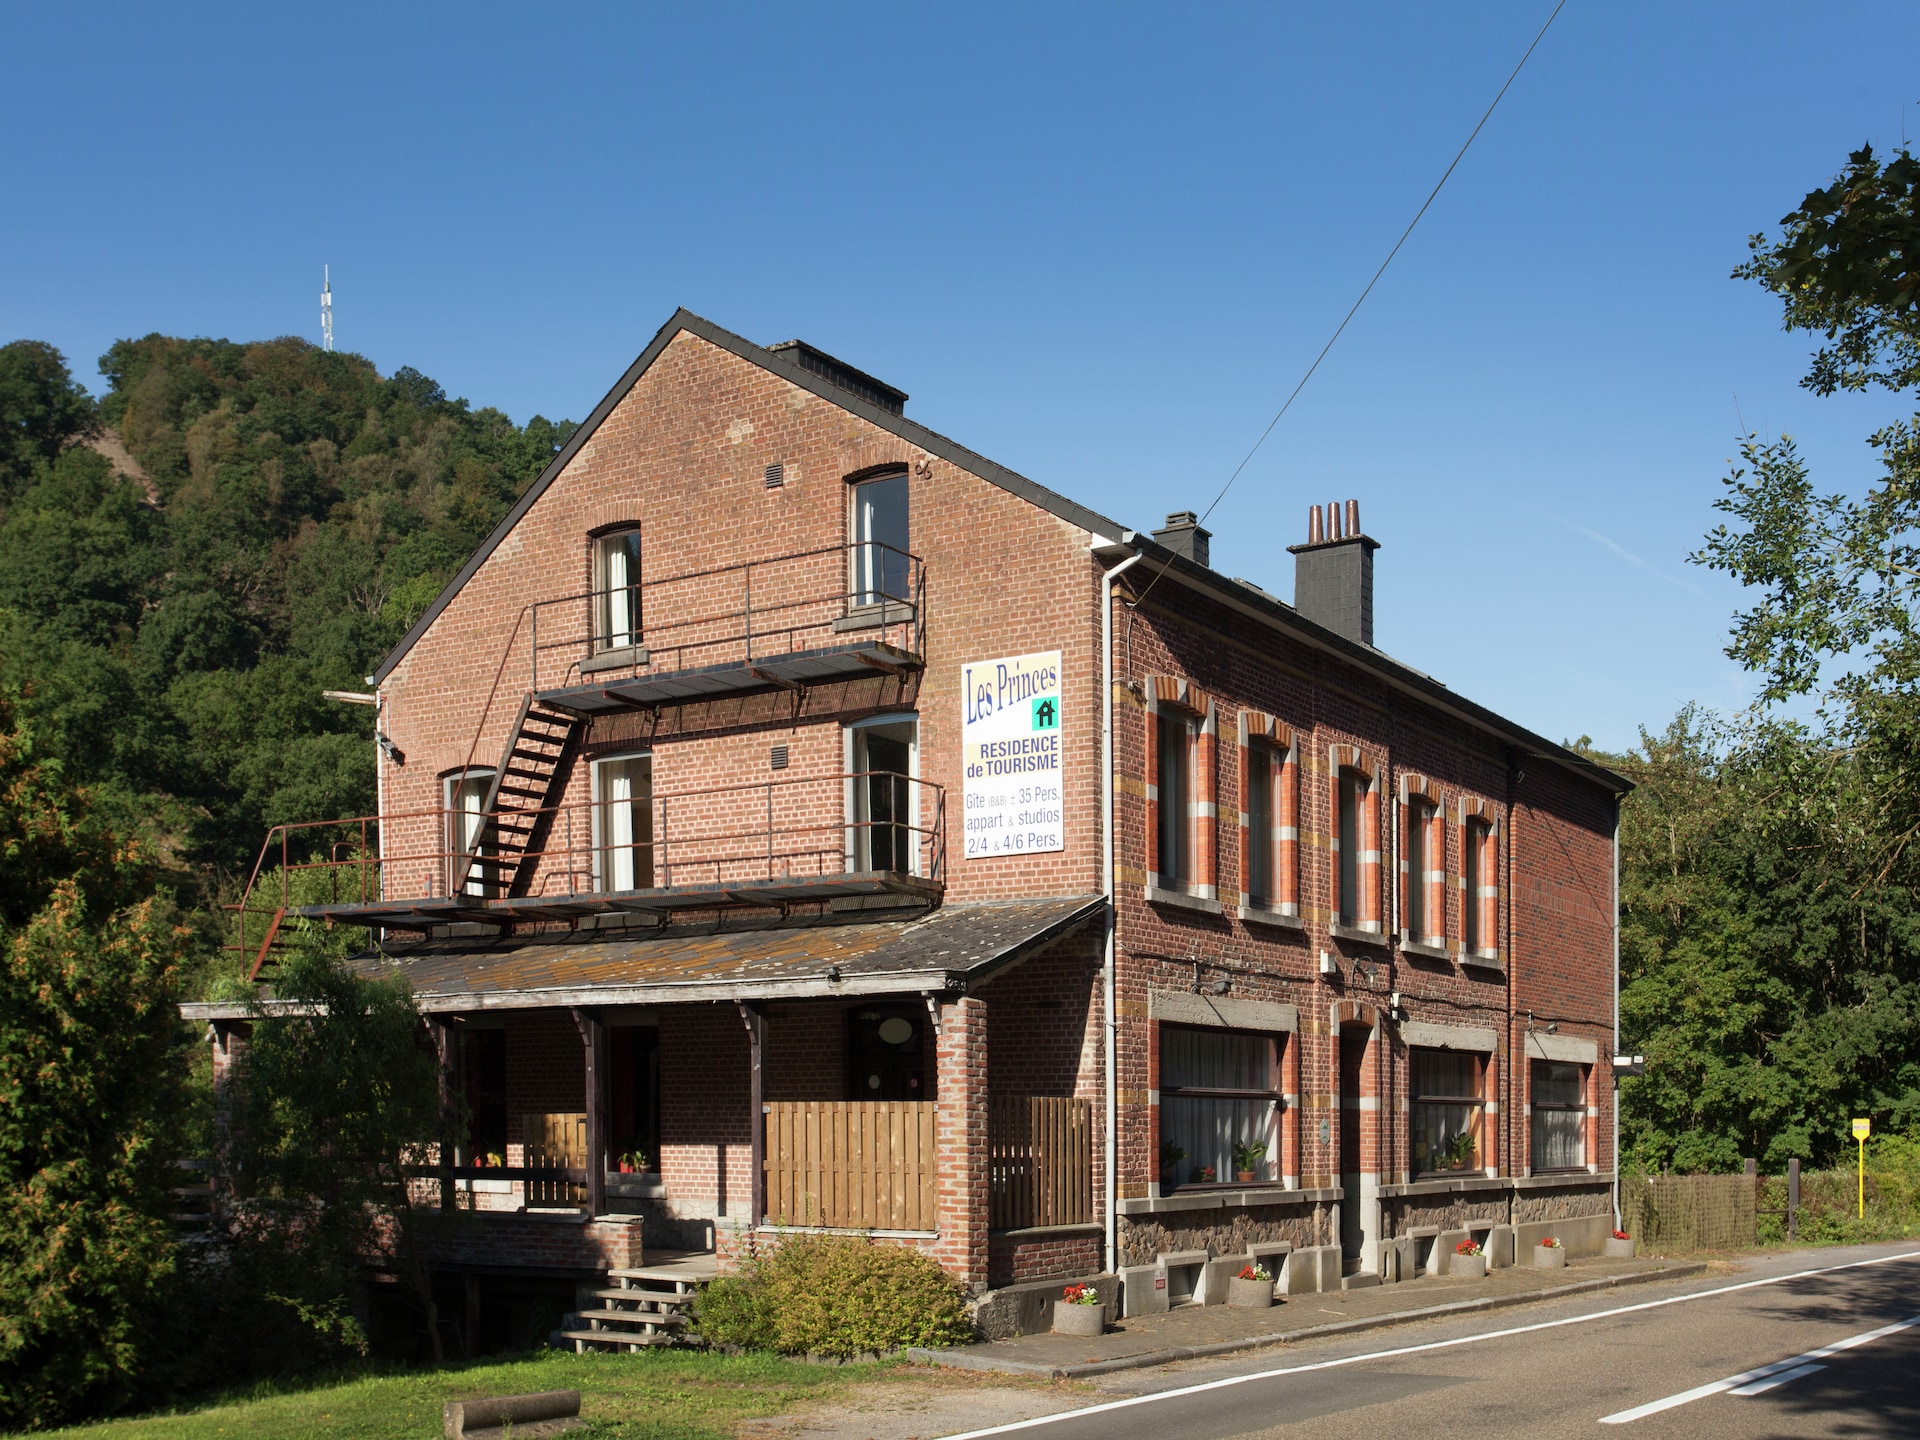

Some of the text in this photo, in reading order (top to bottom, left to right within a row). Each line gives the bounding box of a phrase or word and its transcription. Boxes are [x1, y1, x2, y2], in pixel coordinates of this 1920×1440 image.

[966, 661, 1056, 725] Les Princes
[981, 735, 1058, 759] RESIDENCE
[967, 754, 1058, 778] de TOURISME
[1019, 788, 1032, 804] 35
[1035, 786, 1060, 802] Pers.
[967, 808, 1060, 833] appart & studios
[968, 832, 1059, 853] 2/4 & 4/6 Pers.
